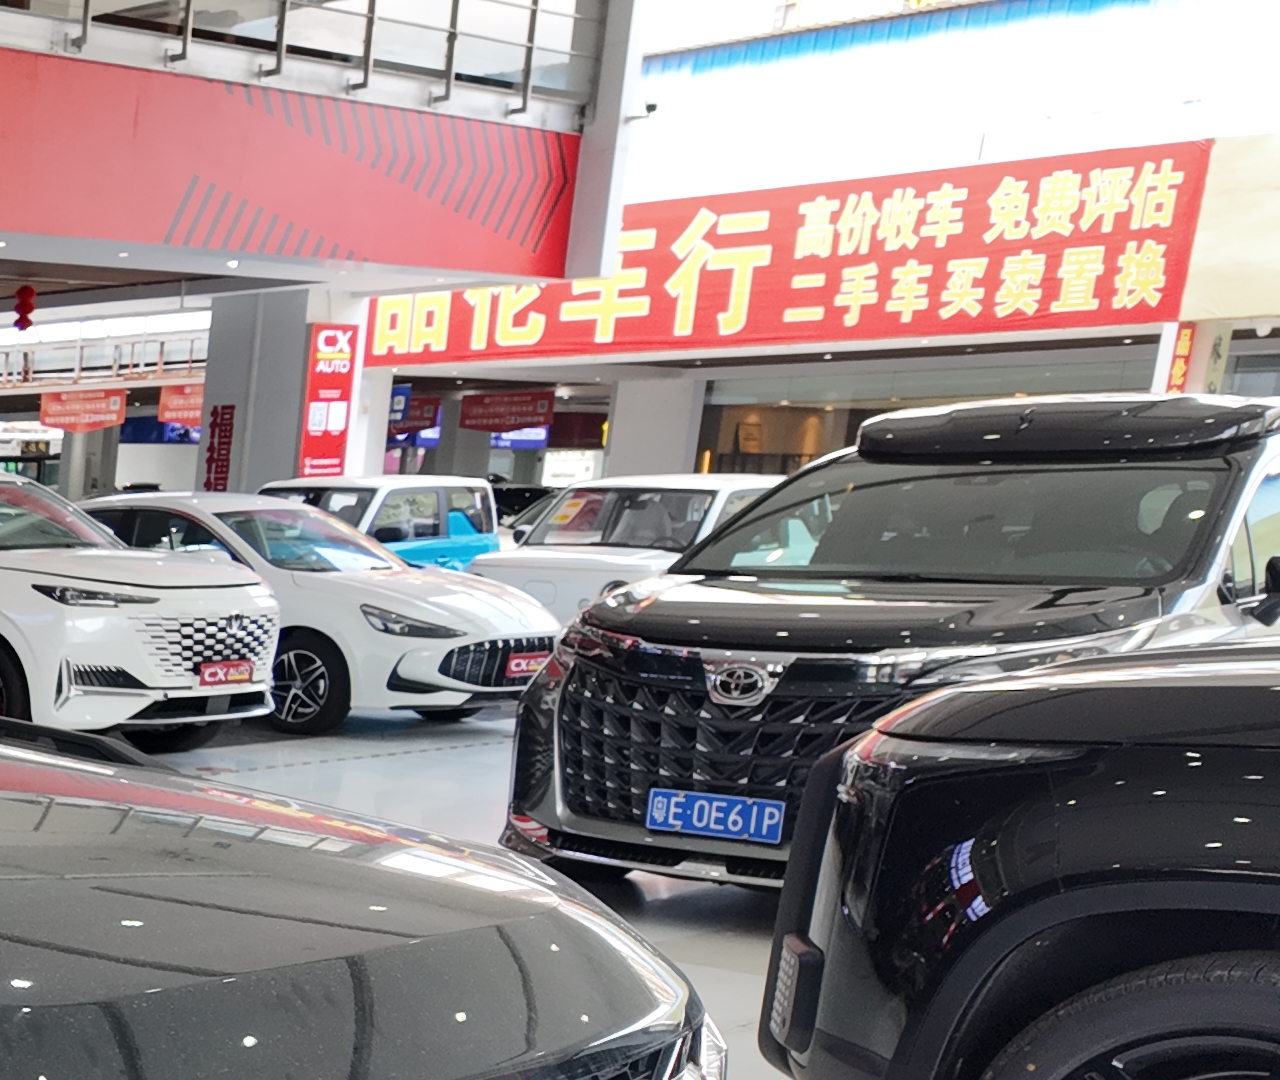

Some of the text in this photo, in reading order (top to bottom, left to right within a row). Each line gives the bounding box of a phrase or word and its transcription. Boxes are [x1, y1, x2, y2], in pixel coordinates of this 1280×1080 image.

[792, 158, 1184, 260] 高价收车 免费评估
[781, 239, 1167, 327] 二手车买卖置换
[317, 329, 354, 354] CX
[315, 360, 351, 374] AUTO
[204, 666, 228, 682] CX
